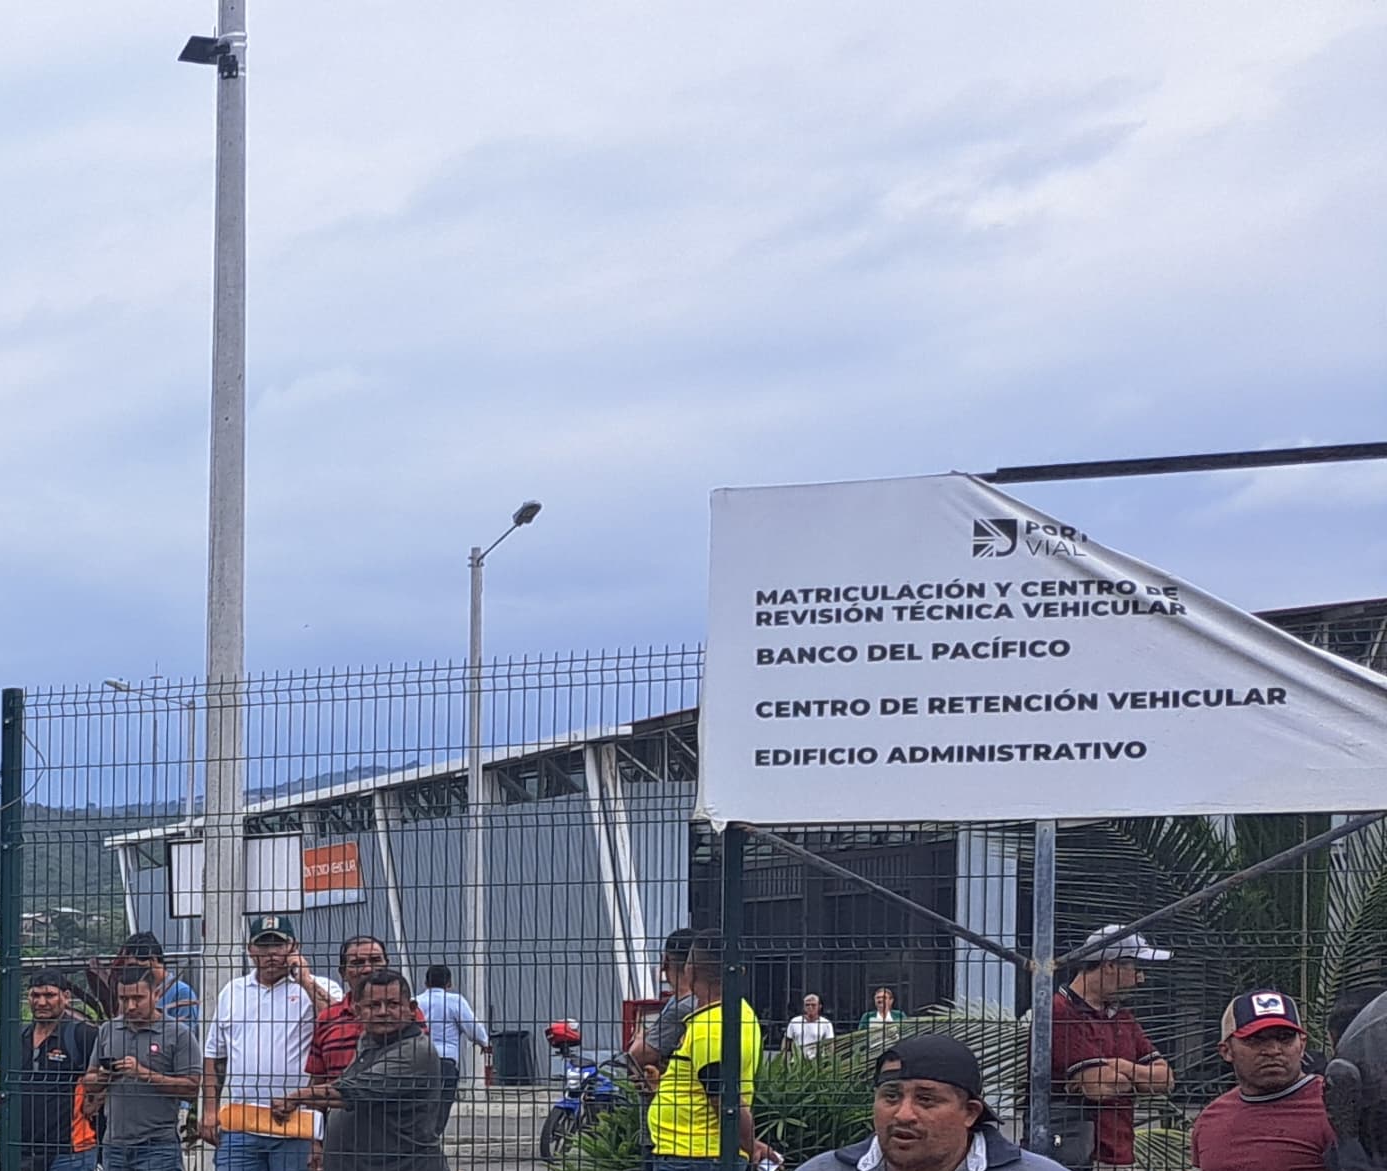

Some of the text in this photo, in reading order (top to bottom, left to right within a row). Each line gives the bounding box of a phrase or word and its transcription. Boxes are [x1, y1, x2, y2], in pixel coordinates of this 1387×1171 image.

[1026, 539, 1087, 556] VIAL
[755, 579, 1179, 606] MATRICULACIÓN Y CENTRO DE
[755, 597, 1187, 627] REVISIÓN TÉCNICA VEHICULAR
[756, 635, 1071, 666] BANCO DEL PACÍFICO
[755, 687, 1288, 719] CENTRO DE RETENCIÓN VEHICULAR
[755, 740, 1148, 767] EDIFICIO ADMINISTRATIVO
